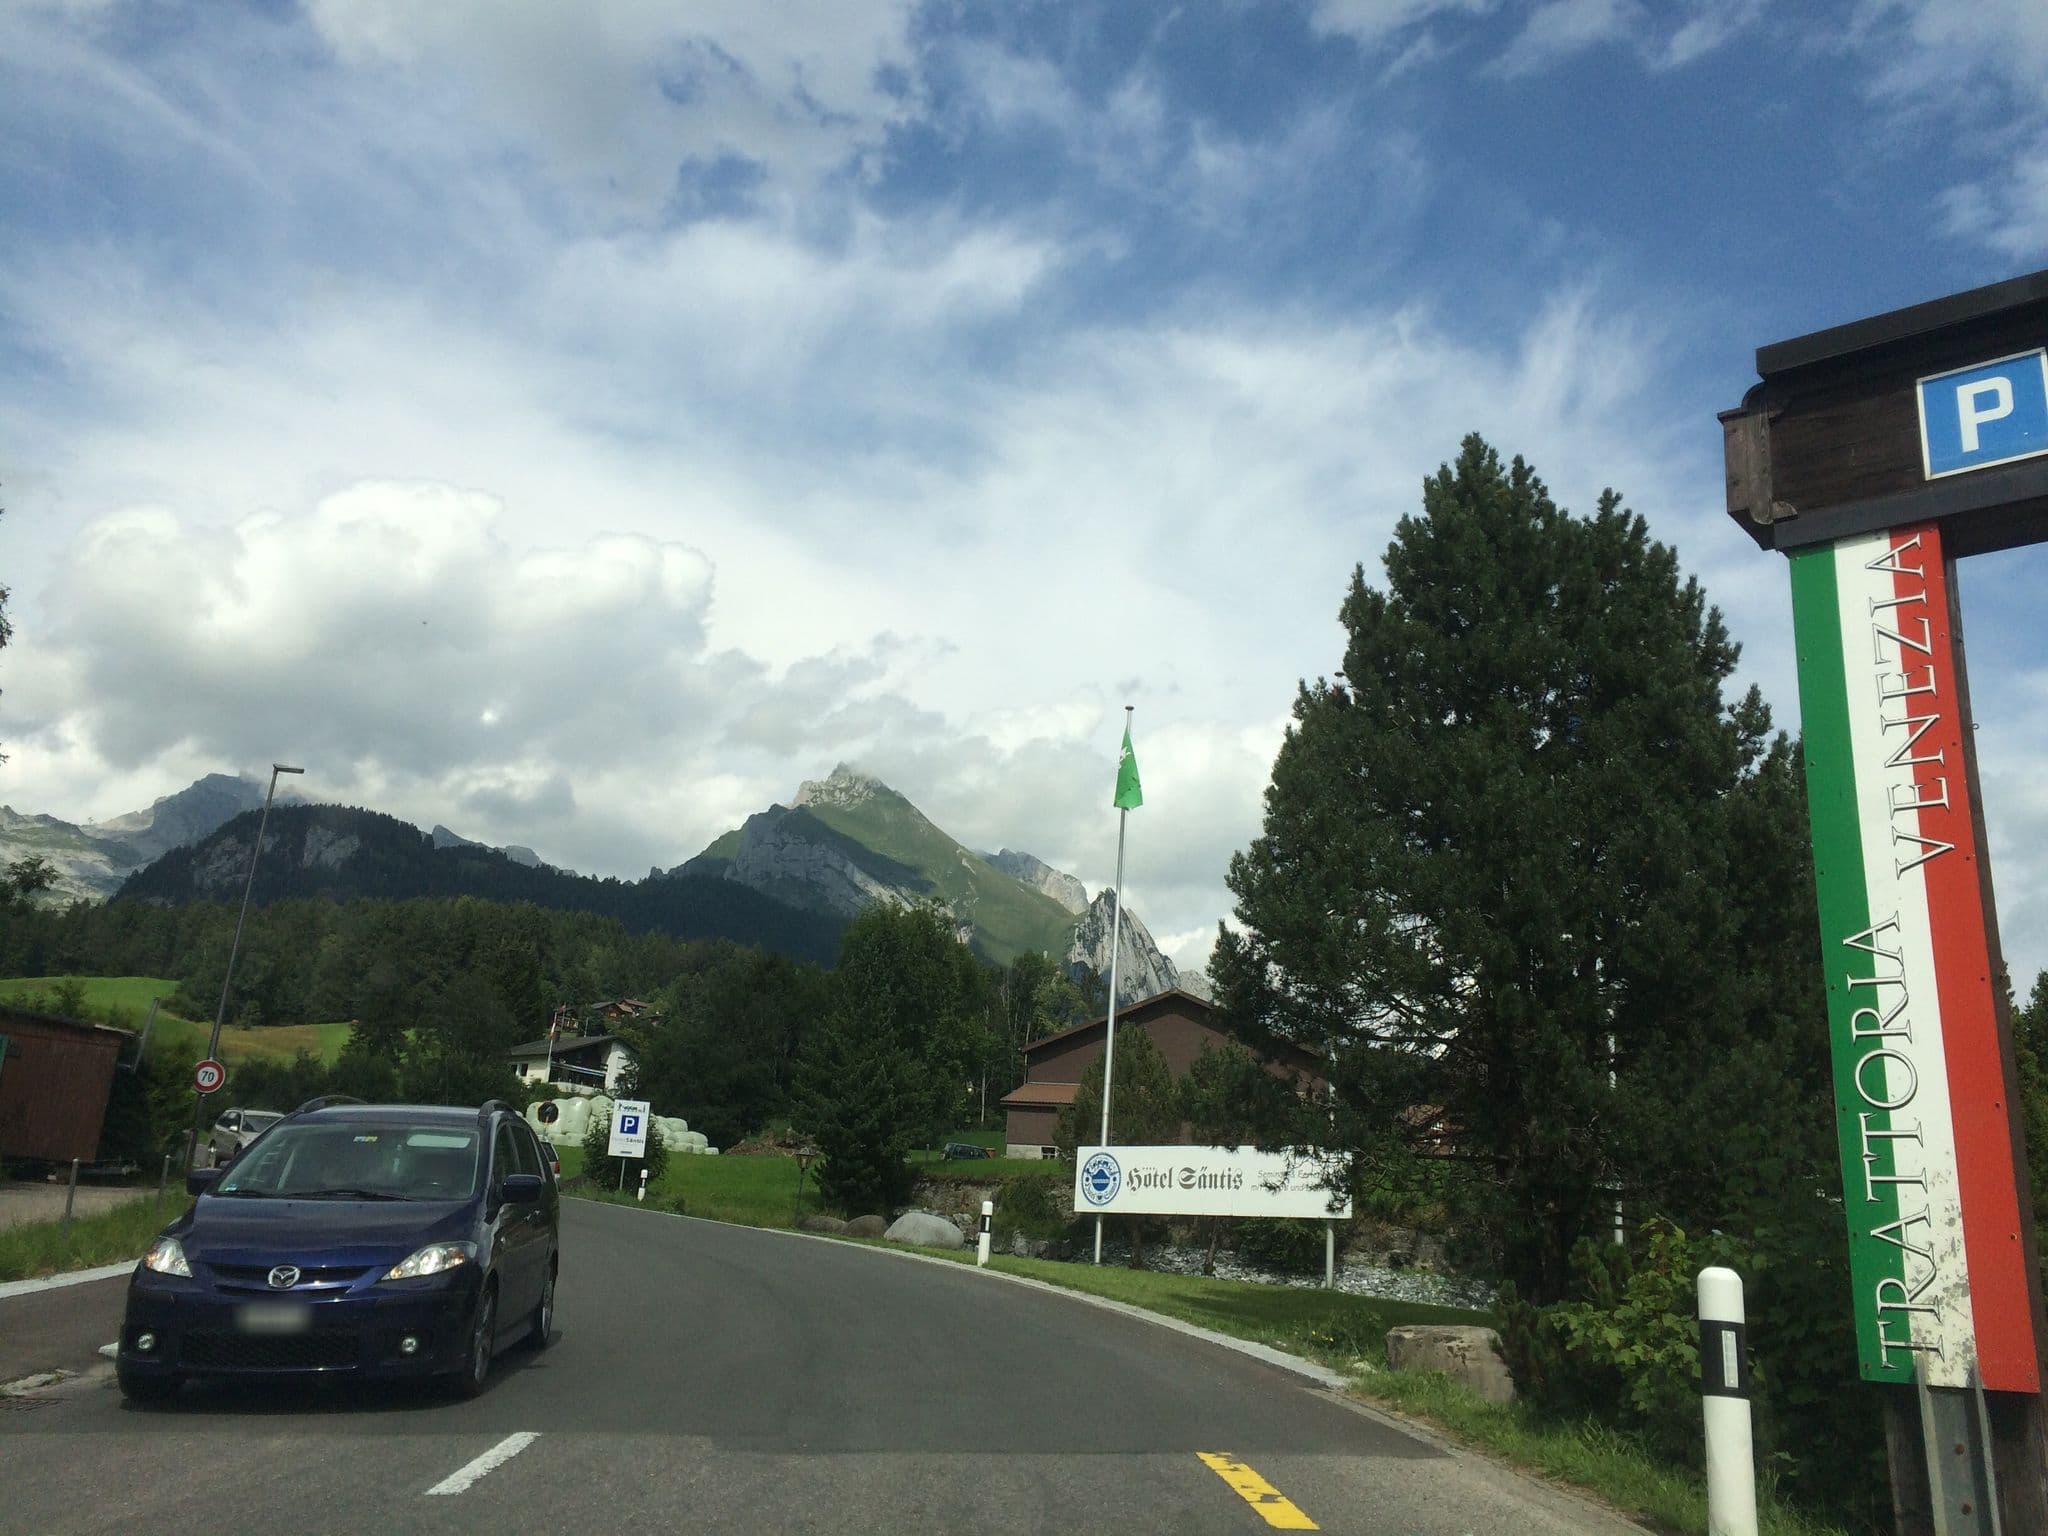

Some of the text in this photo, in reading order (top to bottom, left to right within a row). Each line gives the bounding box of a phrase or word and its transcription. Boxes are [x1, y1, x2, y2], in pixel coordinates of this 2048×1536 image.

[1956, 376, 2014, 453] P
[1842, 532, 1956, 1371] TRATTORIA VENEZIA
[201, 1070, 215, 1082] 70
[623, 1117, 635, 1132] P
[1126, 1166, 1174, 1192] Hotel
[1178, 1165, 1243, 1190] Säntis
